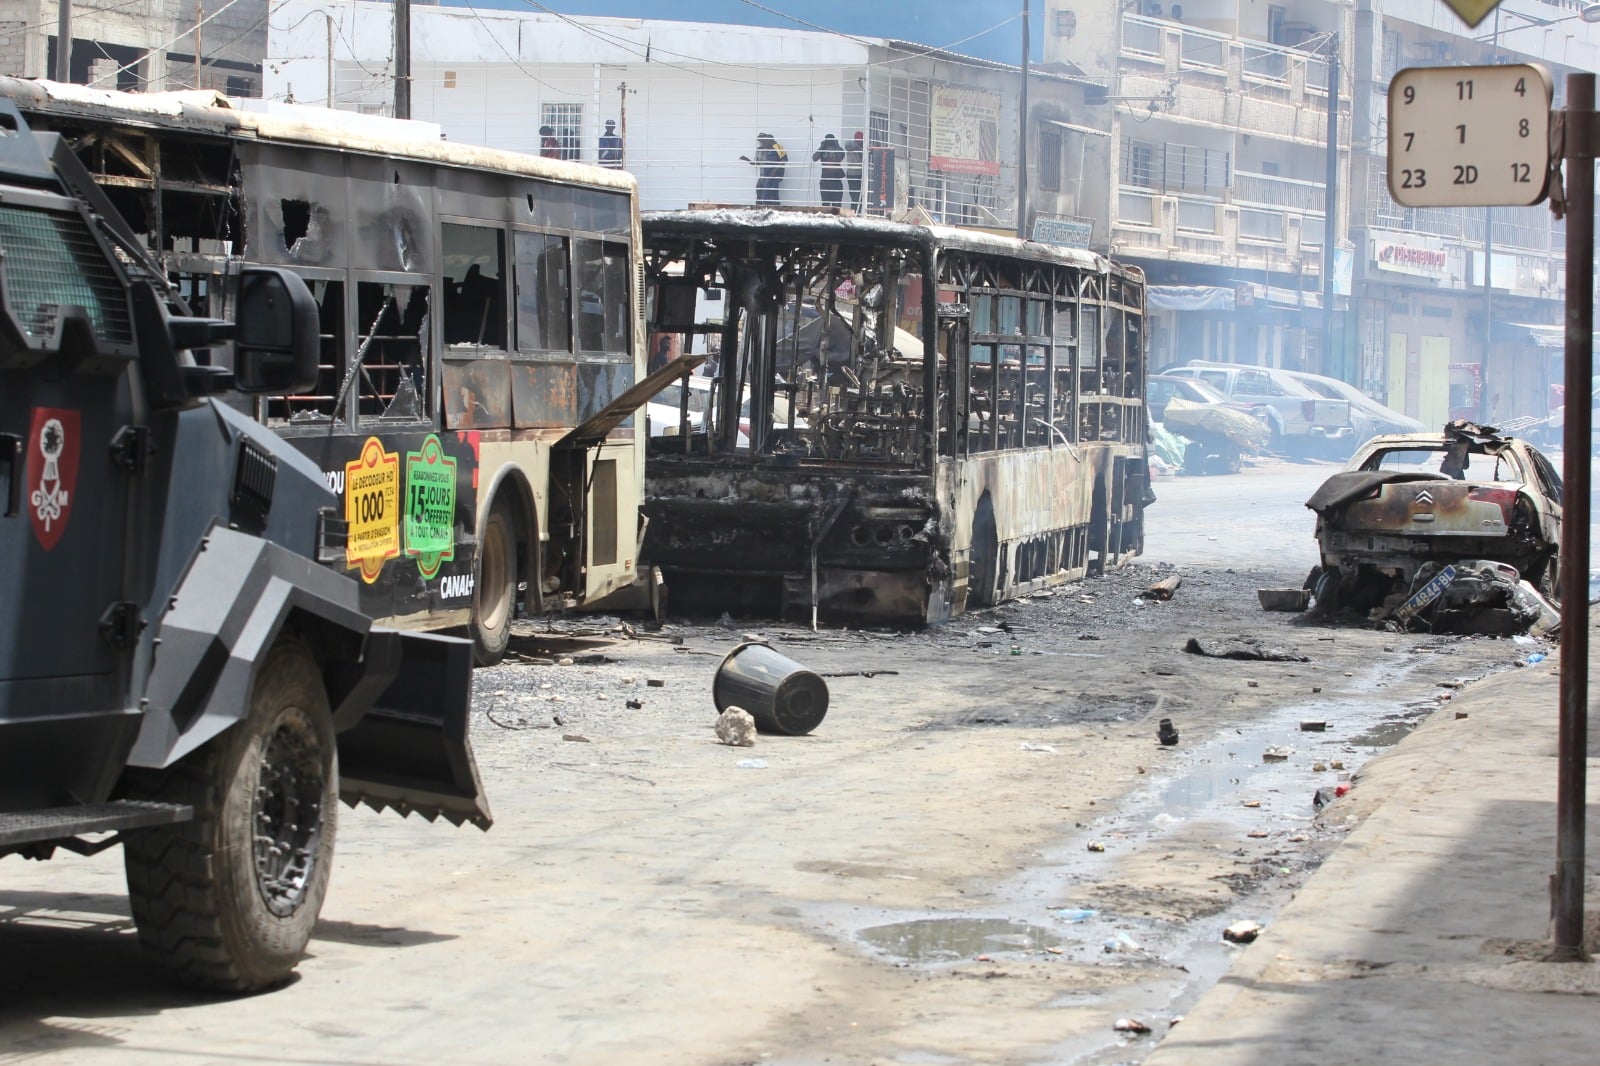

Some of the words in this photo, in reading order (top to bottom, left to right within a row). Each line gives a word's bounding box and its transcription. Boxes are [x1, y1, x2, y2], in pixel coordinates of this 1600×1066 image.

[1404, 85, 1415, 105] 9
[1456, 80, 1473, 100] 11
[1514, 77, 1526, 97] 4
[1404, 132, 1415, 152] 7
[1456, 124, 1466, 144] 1
[1519, 118, 1529, 138] 8
[1401, 169, 1426, 189] 23
[1453, 165, 1478, 185] 2D
[1511, 163, 1530, 183] 12
[411, 485, 426, 524] 15
[426, 487, 450, 507] JOURS
[440, 573, 475, 599] CANAL+
